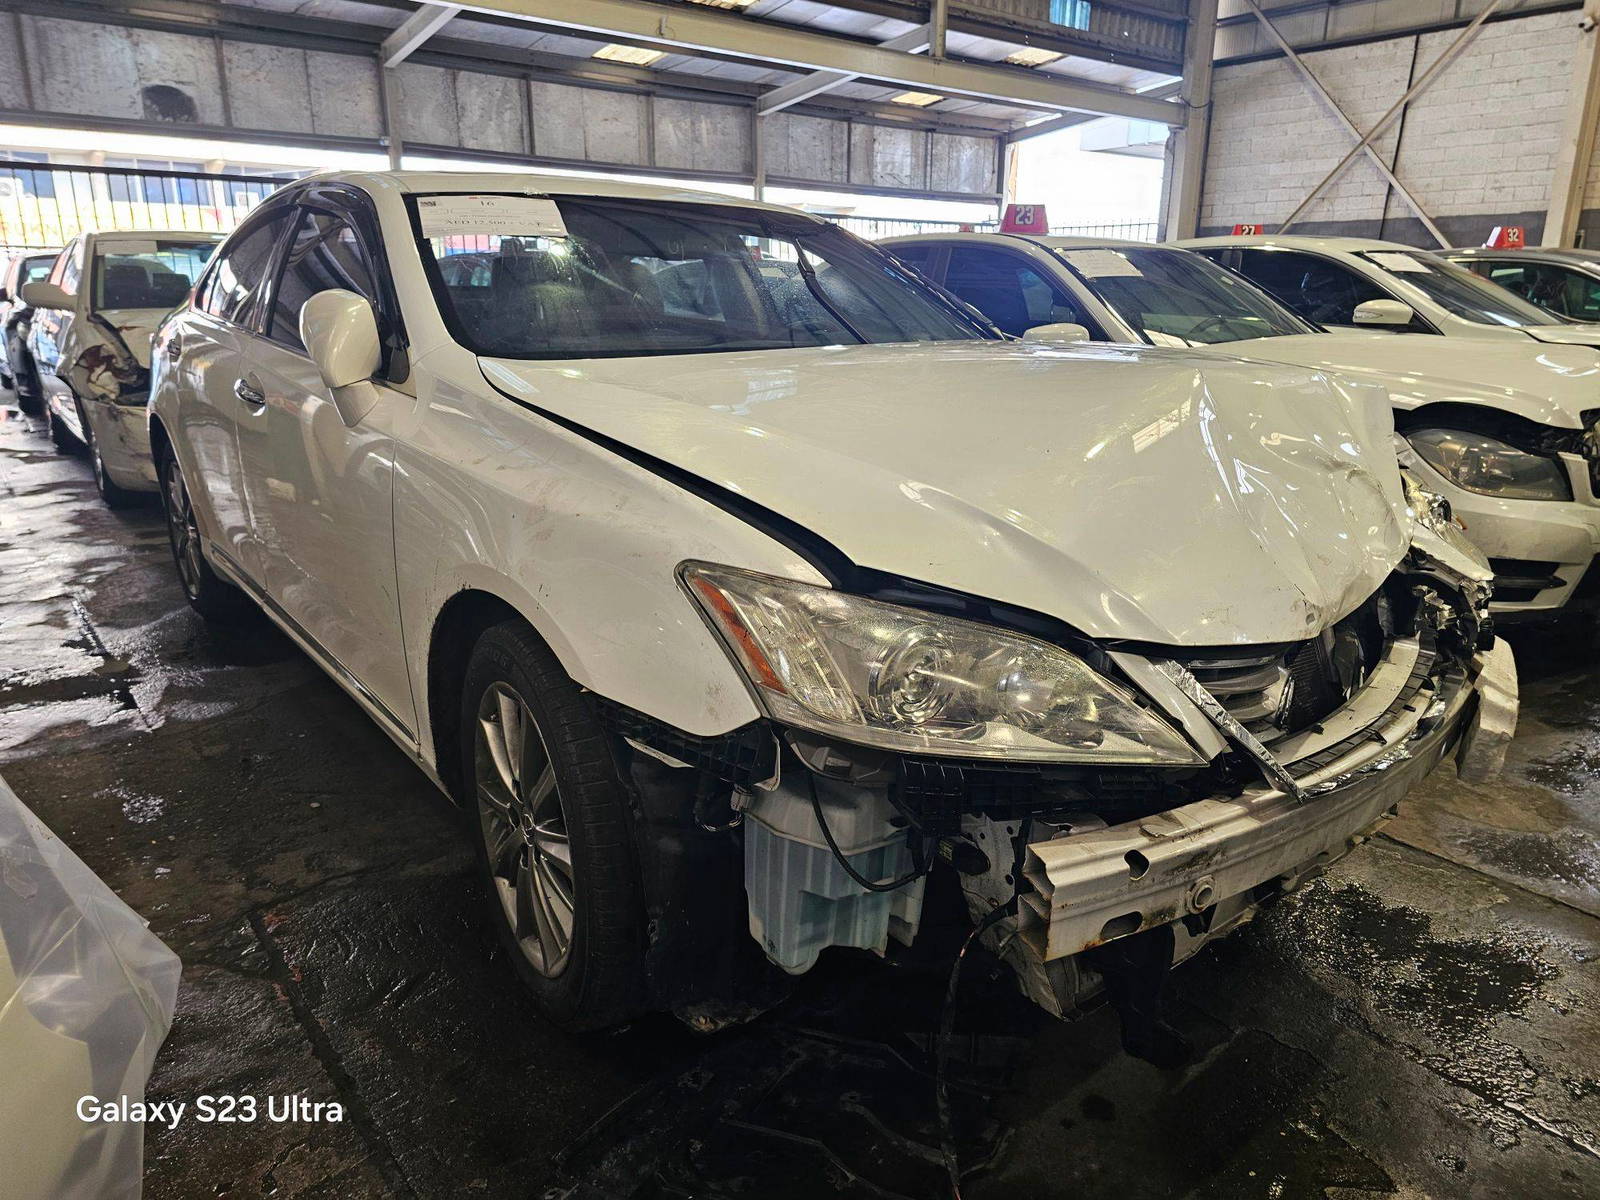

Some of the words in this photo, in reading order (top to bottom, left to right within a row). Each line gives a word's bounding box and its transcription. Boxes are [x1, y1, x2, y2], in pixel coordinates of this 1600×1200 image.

[1015, 205, 1034, 225] 23
[1242, 225, 1256, 235] 27
[1507, 228, 1519, 242] 32
